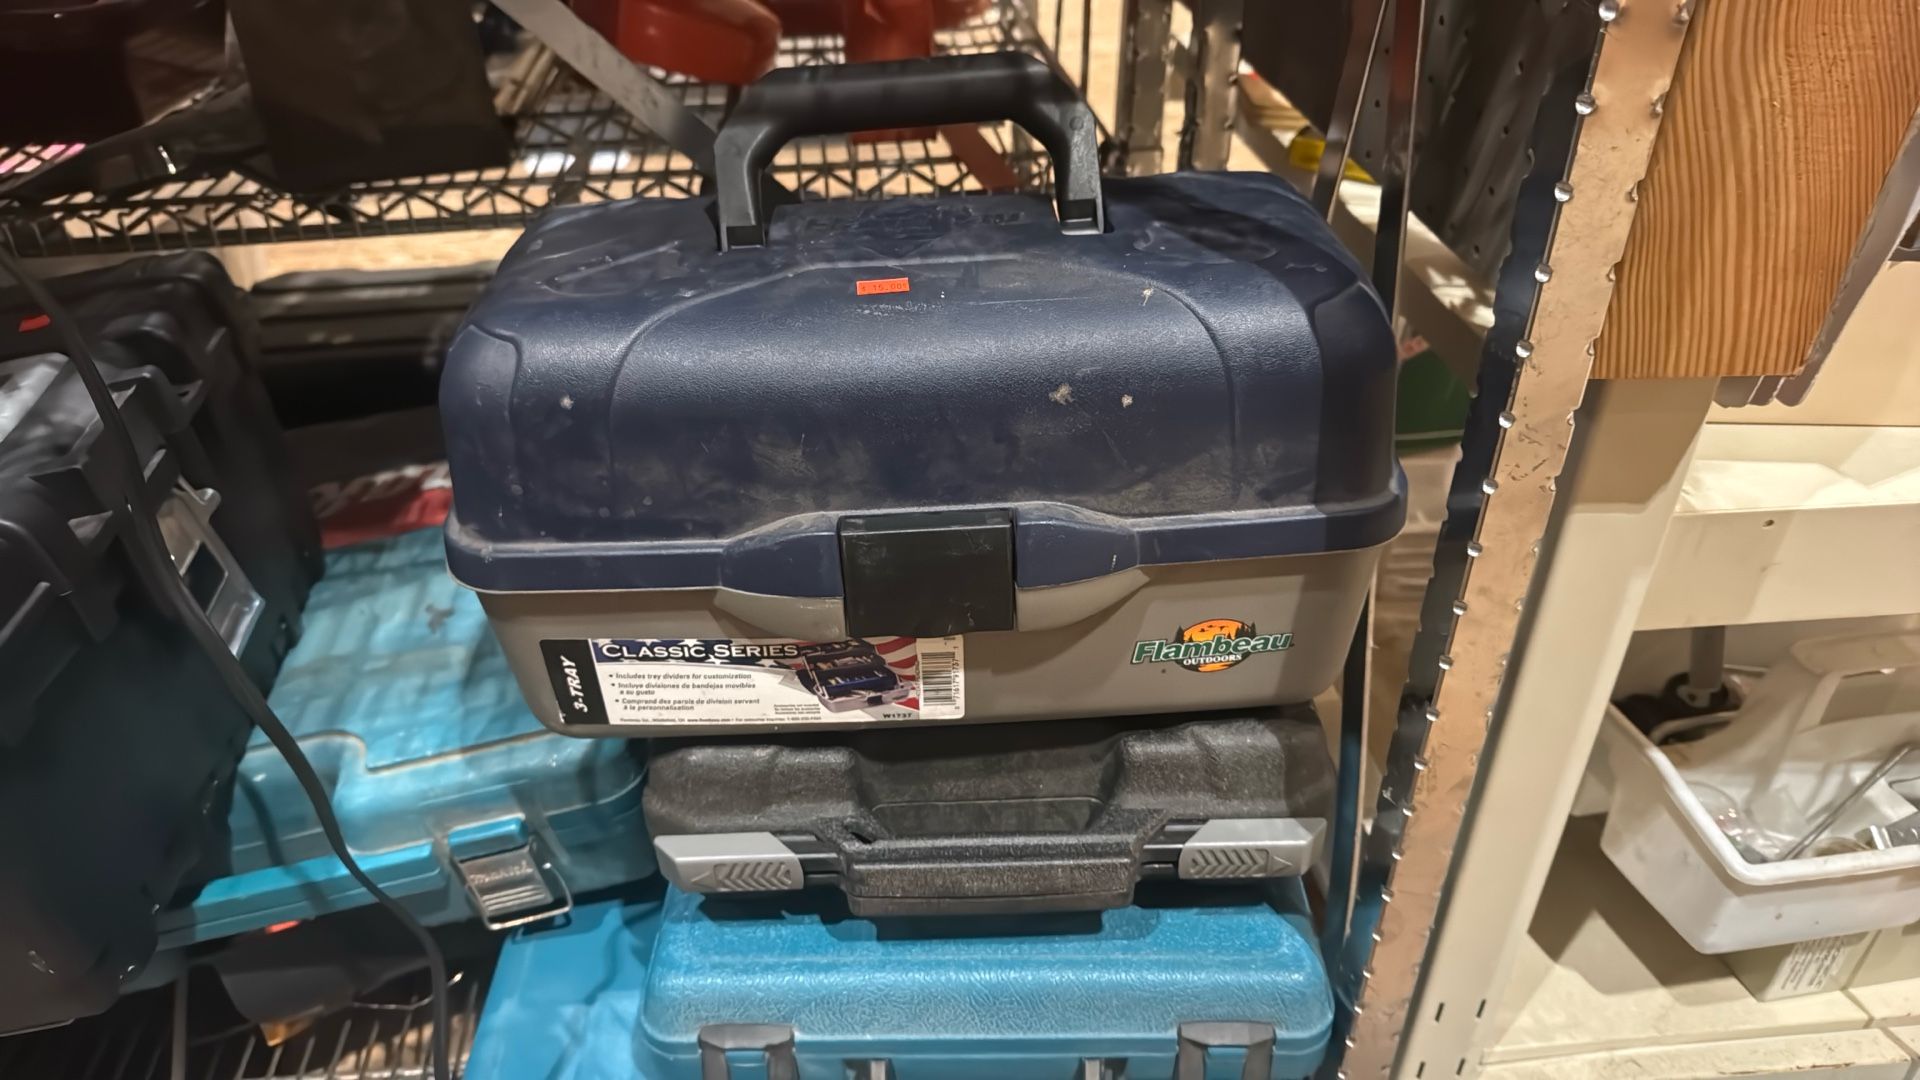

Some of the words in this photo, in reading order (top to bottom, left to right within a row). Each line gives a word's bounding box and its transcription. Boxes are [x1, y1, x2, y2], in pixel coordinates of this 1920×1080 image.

[602, 644, 706, 658] CLASSIC
[713, 644, 799, 658] SERIES
[1130, 633, 1293, 665] Flambeau
[1183, 653, 1243, 666] OUTDOORS
[616, 672, 646, 680] Includes
[662, 672, 691, 680] dividers
[692, 672, 702, 680] for
[559, 654, 588, 713] 3-TRAY
[691, 682, 724, 691] bandejas
